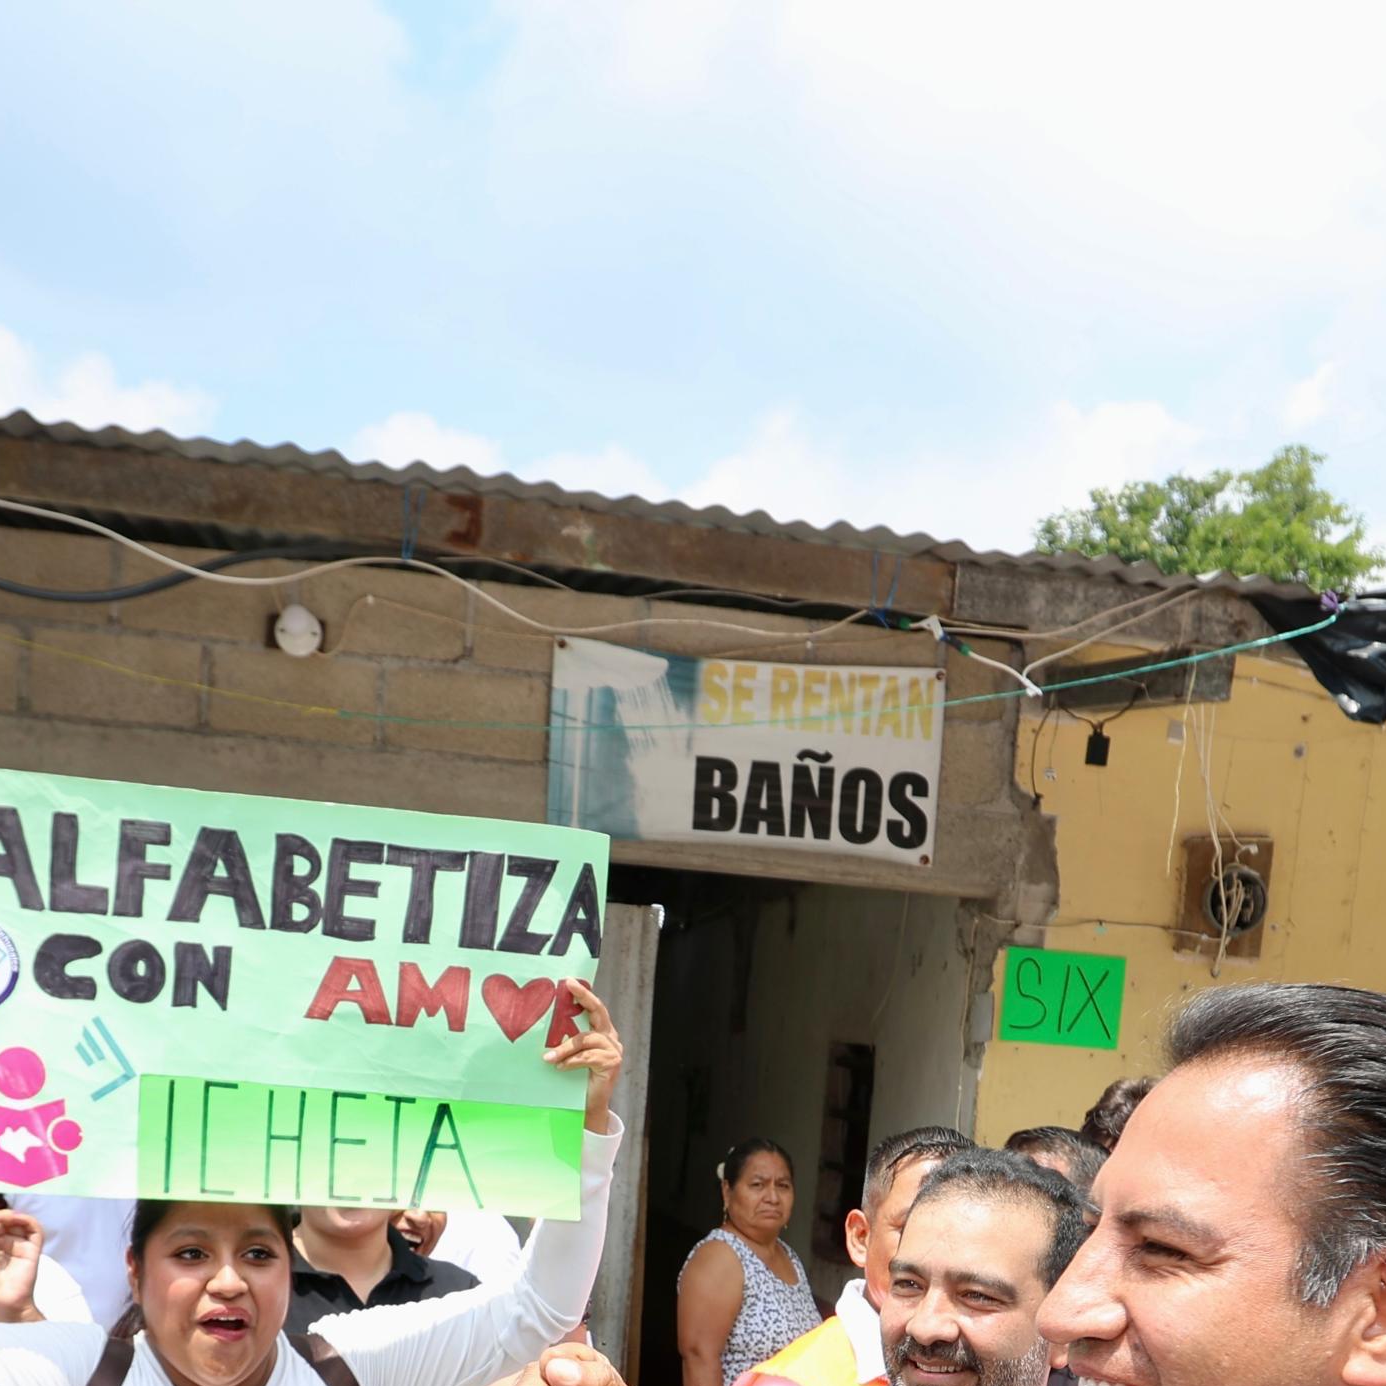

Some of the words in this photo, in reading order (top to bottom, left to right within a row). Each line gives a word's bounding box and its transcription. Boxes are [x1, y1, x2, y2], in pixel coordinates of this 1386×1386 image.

[701, 661, 758, 727] SE
[770, 666, 937, 742] RENTAN
[692, 748, 931, 851] BAÑOS
[33, 933, 233, 1012] CON
[1009, 956, 1112, 1041] SIX
